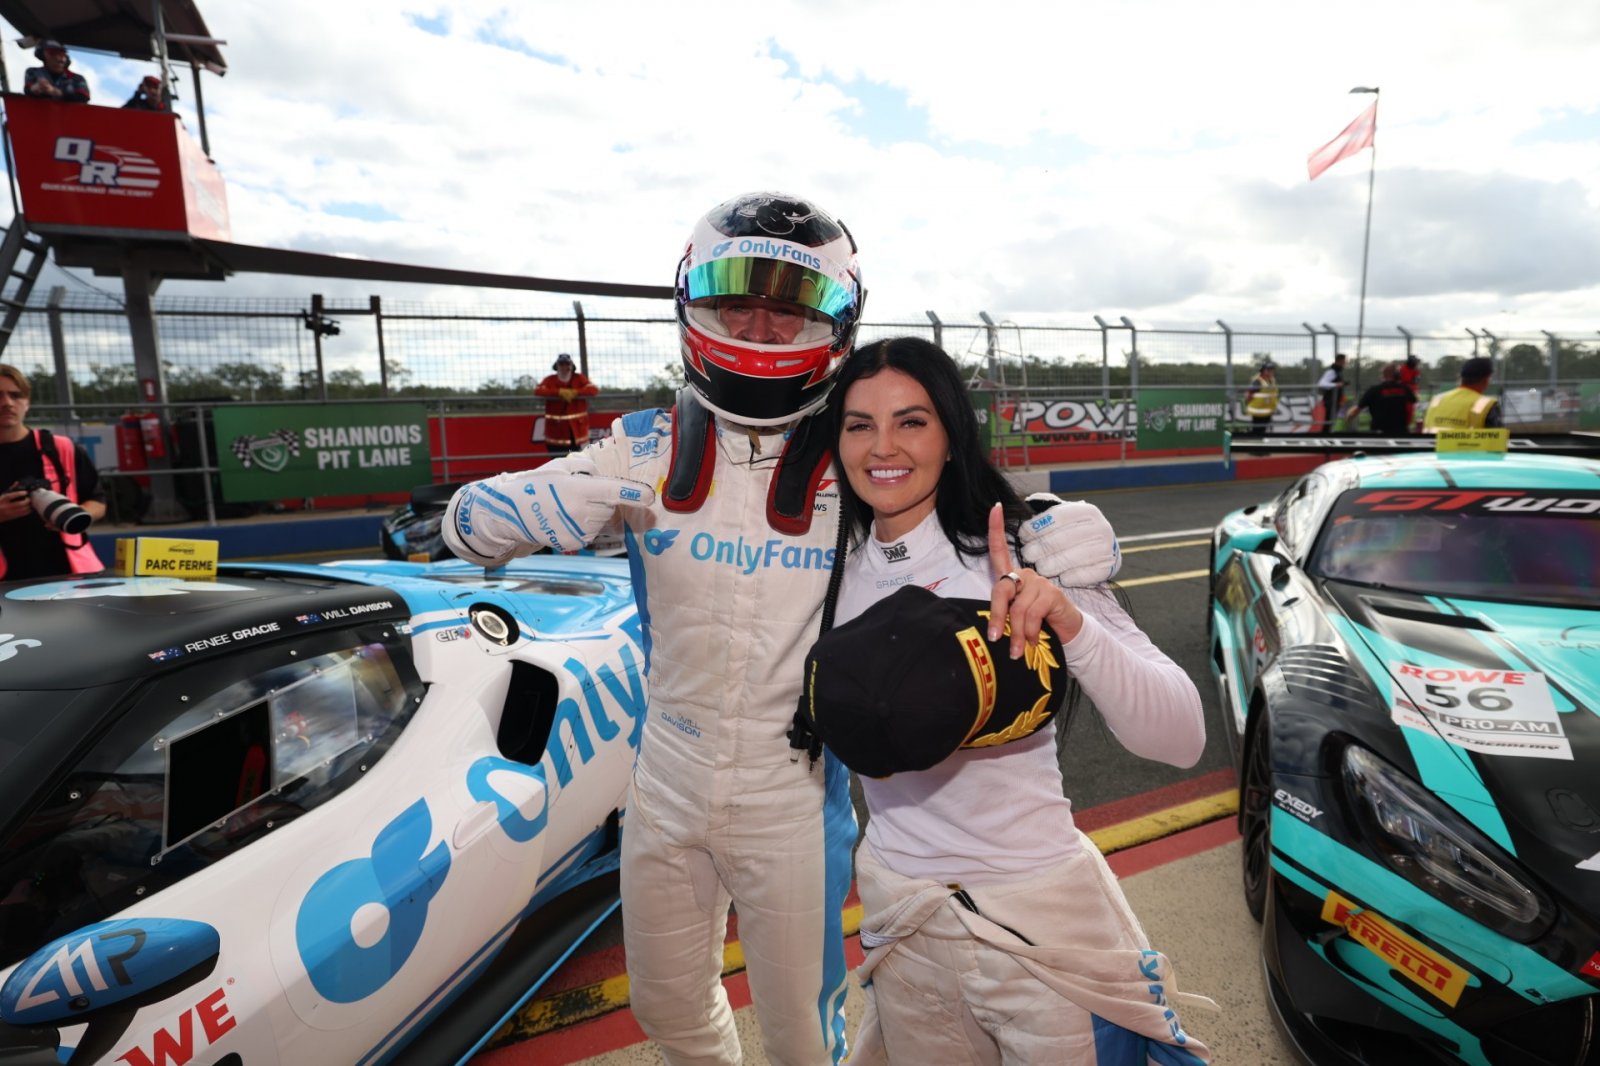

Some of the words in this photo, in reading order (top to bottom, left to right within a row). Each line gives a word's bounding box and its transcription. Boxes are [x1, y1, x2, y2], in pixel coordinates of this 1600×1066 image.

[738, 239, 821, 270] OnlyFans
[1173, 403, 1224, 418] SHANNONS
[1177, 419, 1191, 432] PIT
[1194, 418, 1217, 431] LANE
[304, 425, 422, 448] SHANNONS
[317, 450, 350, 469] PIT
[358, 448, 411, 468] LANE
[619, 490, 641, 500] OMP
[1353, 491, 1526, 512] GT
[1482, 497, 1600, 513] WO
[458, 493, 474, 536] OMP
[813, 503, 827, 511] WS
[1032, 515, 1053, 530] OMP
[690, 532, 836, 575] OnlyFans
[883, 545, 908, 560] OMP
[145, 559, 176, 570] PARC
[178, 560, 213, 571] FERME
[876, 574, 914, 589] GRACIE
[321, 609, 350, 621] WILL
[350, 601, 393, 616] DAVISON
[185, 633, 231, 653] RENEE
[231, 622, 280, 641] GRACIE
[436, 629, 459, 642] elf
[1400, 665, 1526, 685] ROWE
[1425, 684, 1513, 712] 56
[661, 711, 701, 738] DAVISON
[1445, 716, 1550, 733] PRO-AM
[1274, 789, 1324, 818] EXEDY
[1334, 903, 1452, 991] PIRELLI
[113, 987, 237, 1066] WE
